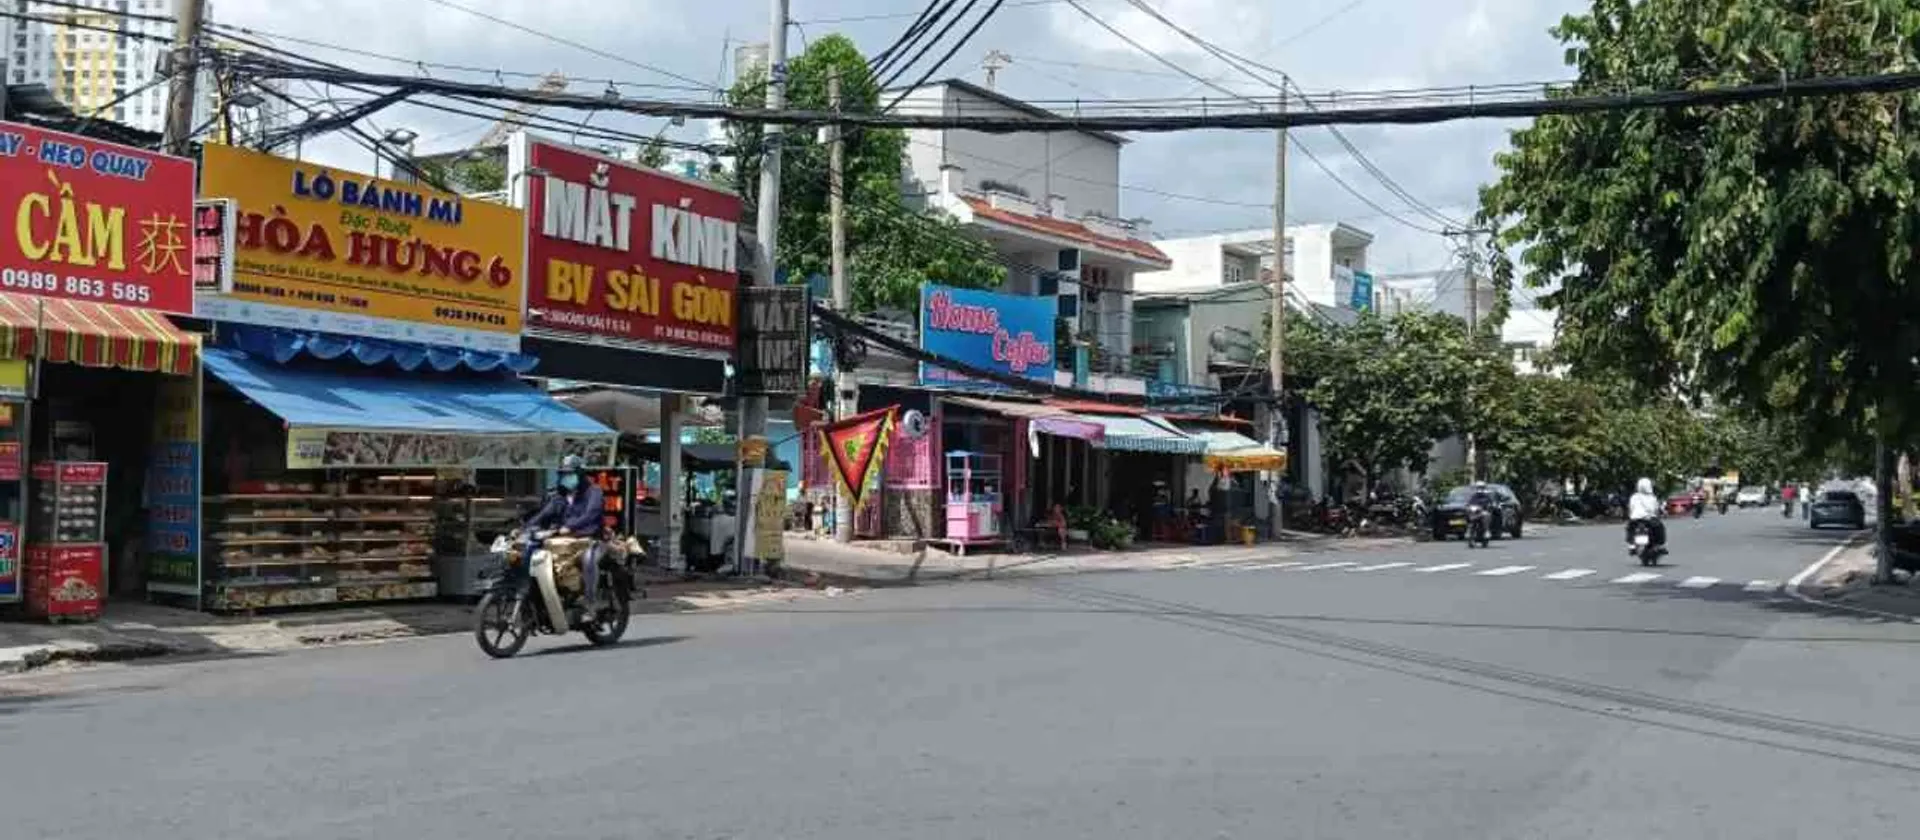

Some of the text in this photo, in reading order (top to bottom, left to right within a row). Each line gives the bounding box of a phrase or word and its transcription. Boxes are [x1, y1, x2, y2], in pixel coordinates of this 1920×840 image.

[90, 150, 151, 180] QUAY
[340, 179, 423, 218] BÁNH
[16, 168, 125, 270] CẦM
[236, 204, 337, 262] HÒA
[346, 230, 482, 285] HƯNG
[488, 254, 513, 290] 6
[543, 163, 738, 275] MẮT KÍNH
[2, 268, 150, 302] 0989 863 585
[547, 258, 594, 306] BV
[605, 263, 660, 317] SÀI
[671, 273, 732, 328] GÒN
